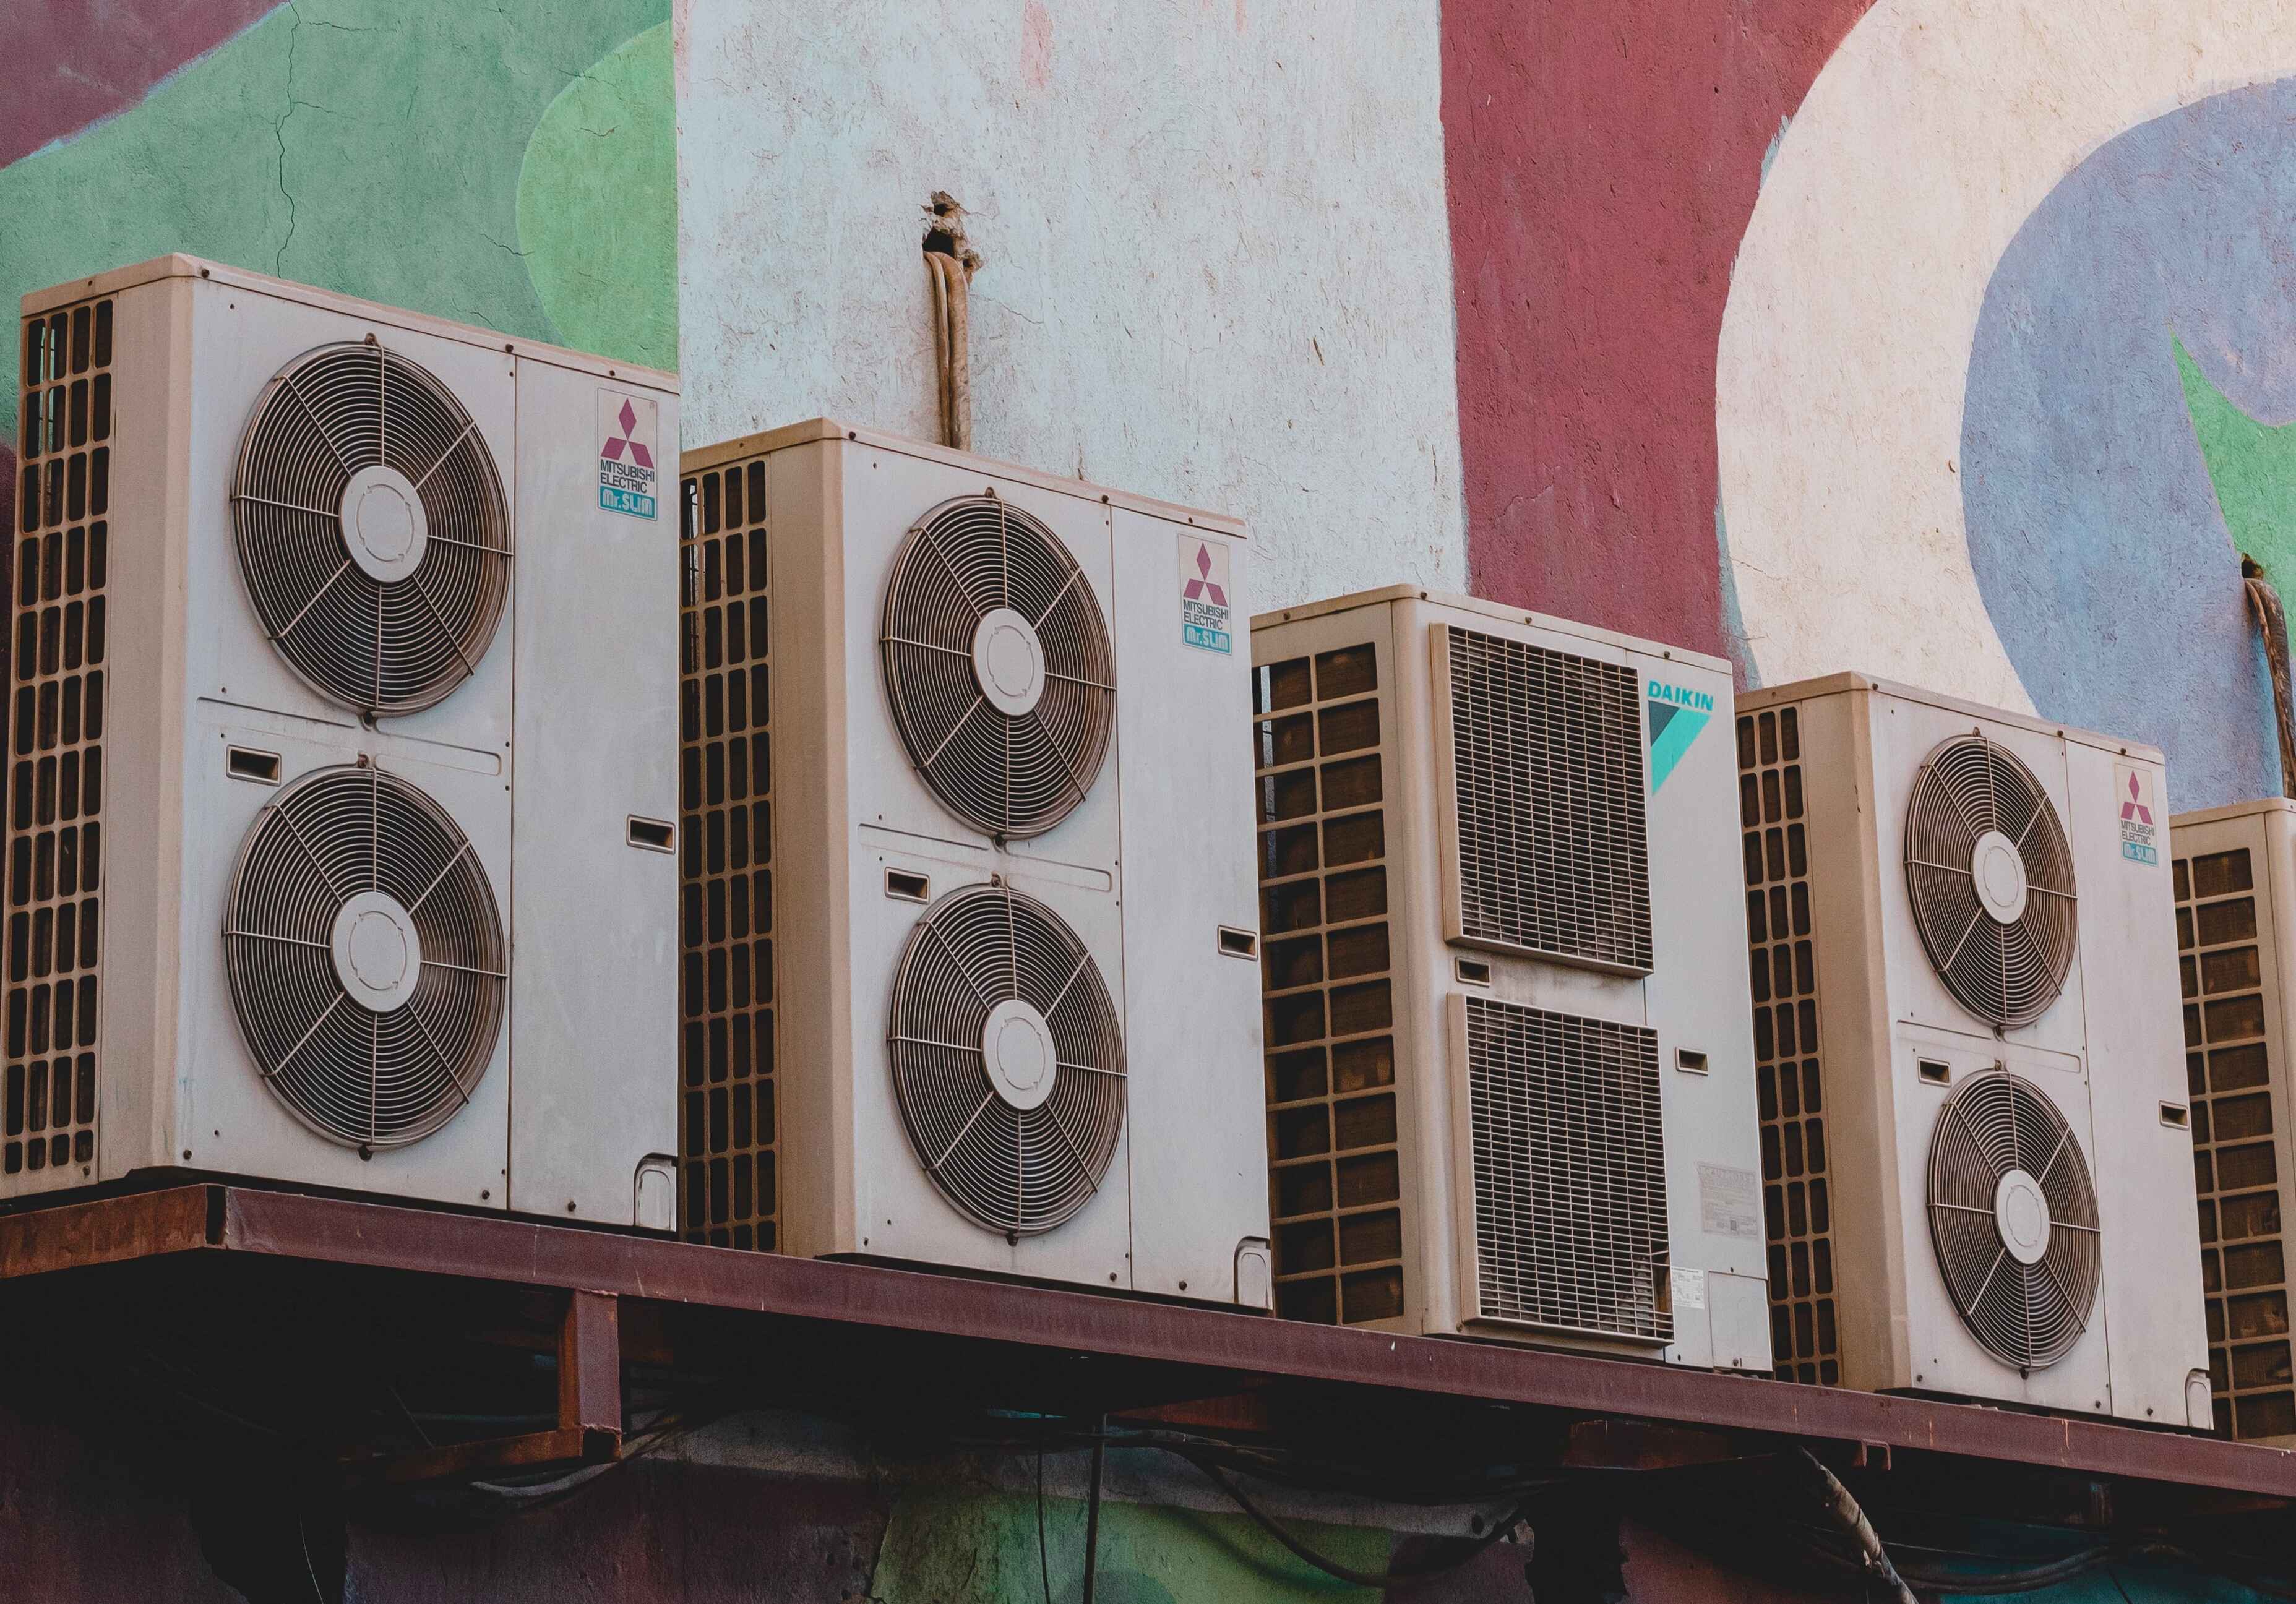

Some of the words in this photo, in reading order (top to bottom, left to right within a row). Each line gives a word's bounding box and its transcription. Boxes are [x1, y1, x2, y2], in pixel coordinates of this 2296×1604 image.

[600, 459, 655, 482] MITSUBISHI
[600, 473, 647, 494] ELECTRIC
[1183, 599, 1229, 620] MITSUBISHI
[1184, 611, 1223, 631] ELECTRIC
[1648, 680, 1713, 711] DAIKIN
[2121, 820, 2154, 837] MITSUBISHI
[2122, 830, 2151, 846] ELECTRIC
